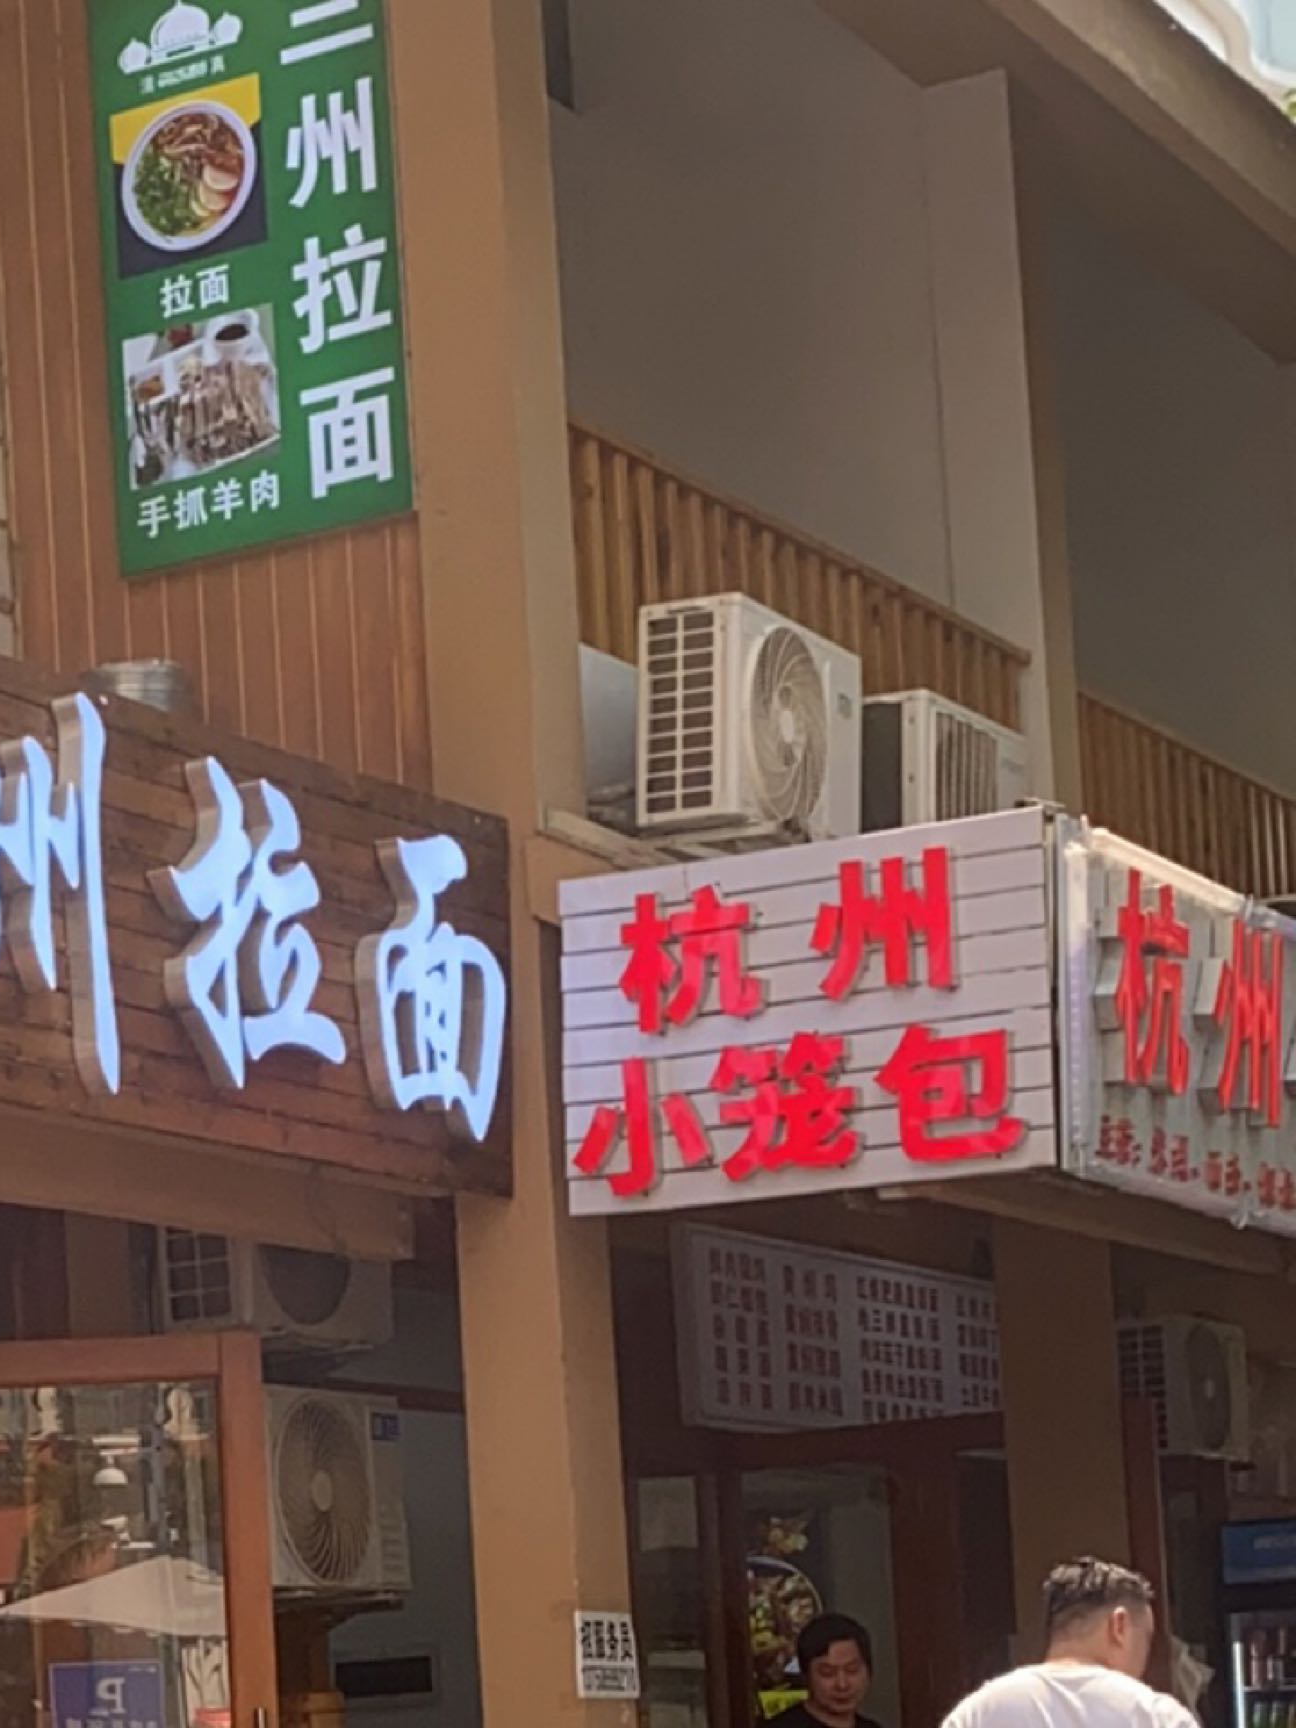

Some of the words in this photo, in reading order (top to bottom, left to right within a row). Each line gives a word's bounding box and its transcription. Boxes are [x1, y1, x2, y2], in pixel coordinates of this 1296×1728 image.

[160, 264, 230, 318] 拉面
[137, 470, 281, 539] 手抓羊肉
[618, 845, 957, 1034] 杭州
[572, 1022, 1028, 1198] 小笼包
